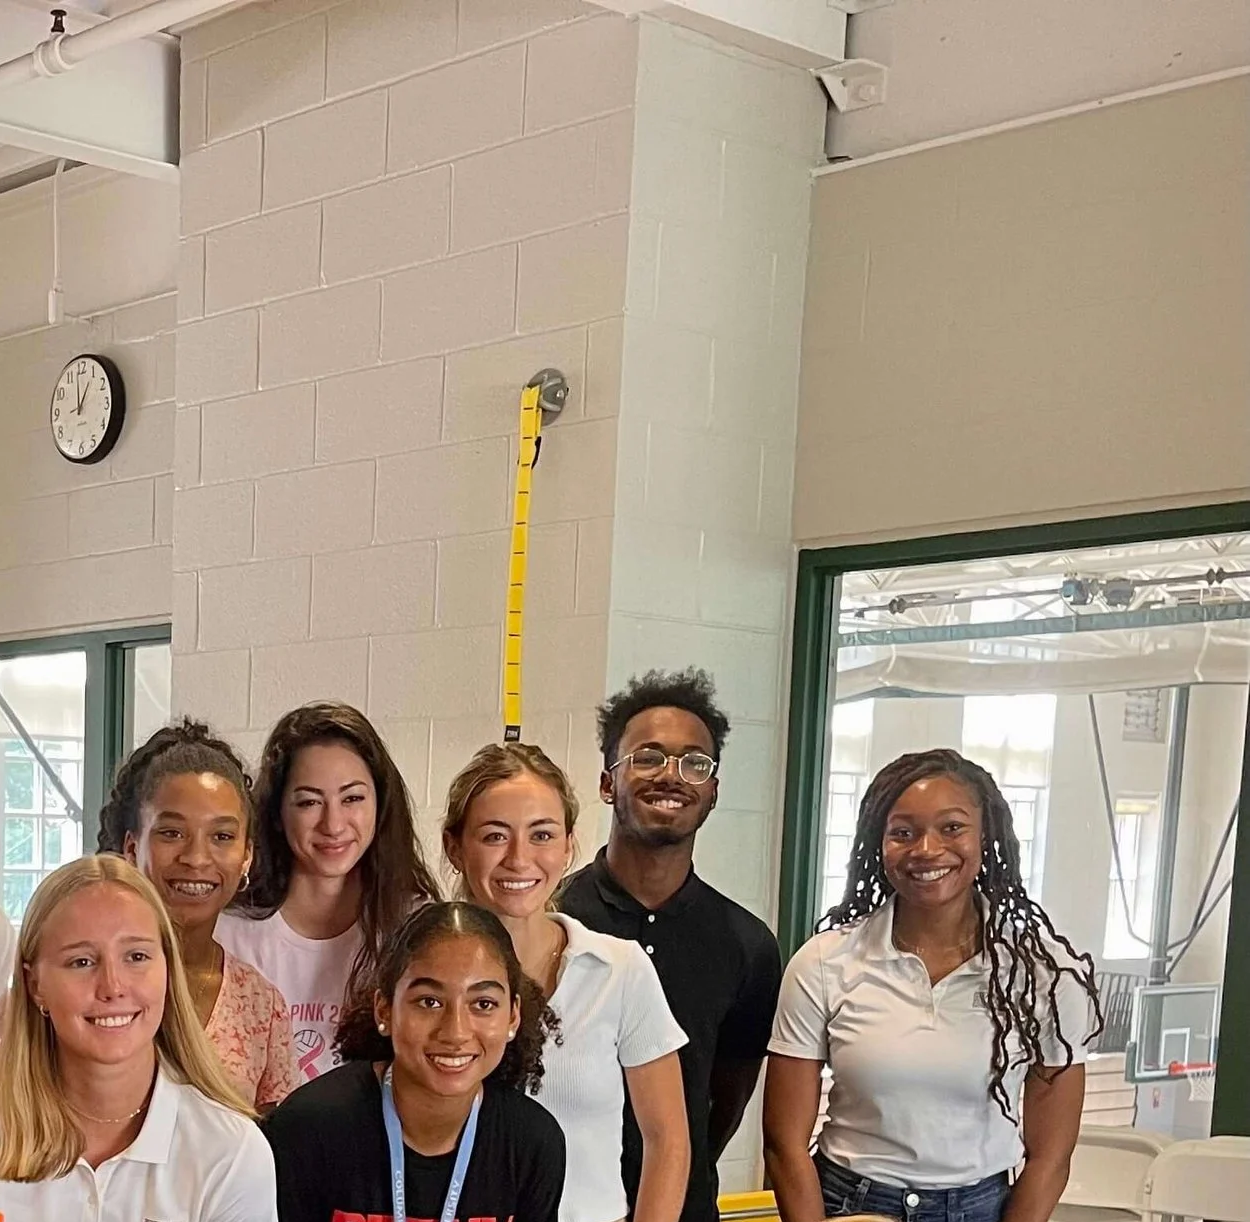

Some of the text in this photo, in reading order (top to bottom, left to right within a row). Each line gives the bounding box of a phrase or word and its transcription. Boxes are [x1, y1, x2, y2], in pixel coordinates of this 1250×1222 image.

[77, 361, 87, 375] 12
[66, 371, 73, 384] 11
[56, 387, 65, 401] 10
[290, 1003, 325, 1022] PINK
